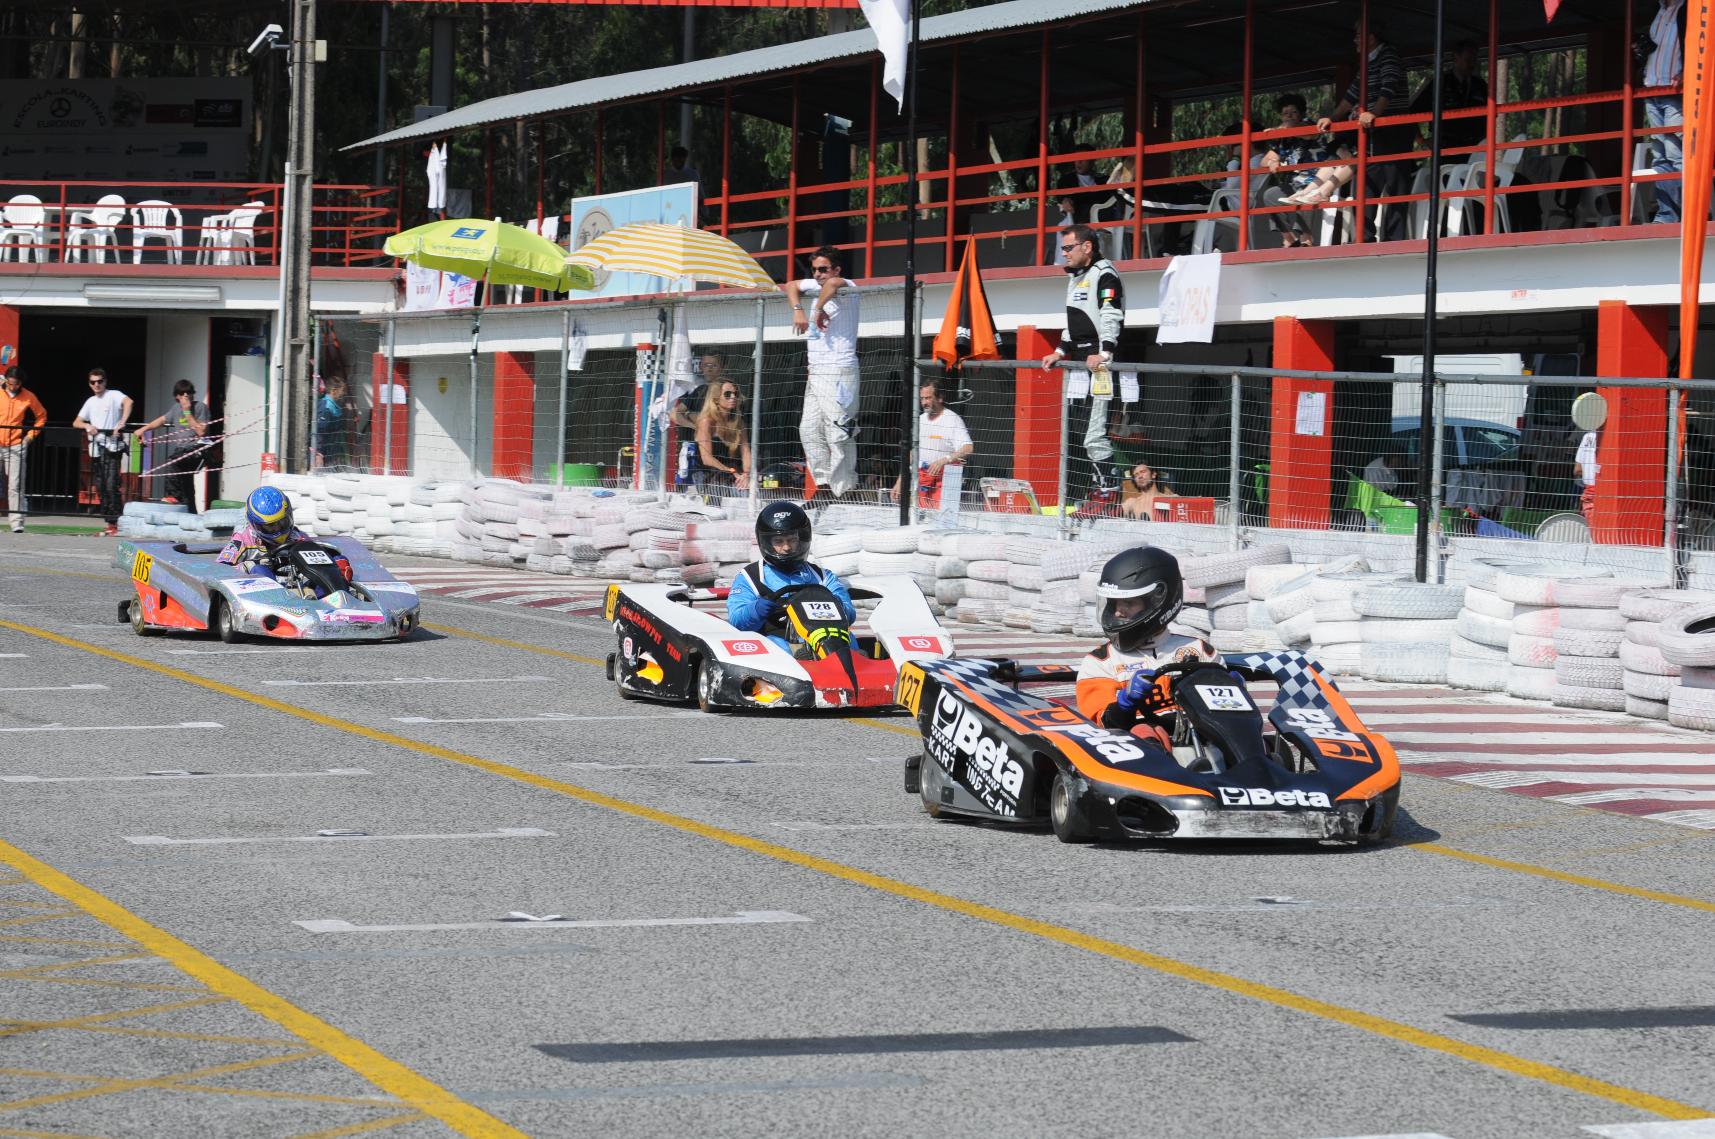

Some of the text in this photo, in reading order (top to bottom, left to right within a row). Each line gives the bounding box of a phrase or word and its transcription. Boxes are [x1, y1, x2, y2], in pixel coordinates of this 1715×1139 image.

[301, 551, 326, 559] 105
[133, 552, 152, 583] 105
[808, 603, 832, 611] 128
[899, 671, 921, 712] 127
[1206, 687, 1234, 697] 127
[953, 709, 1025, 799] Beta
[1246, 788, 1331, 809] Beta
